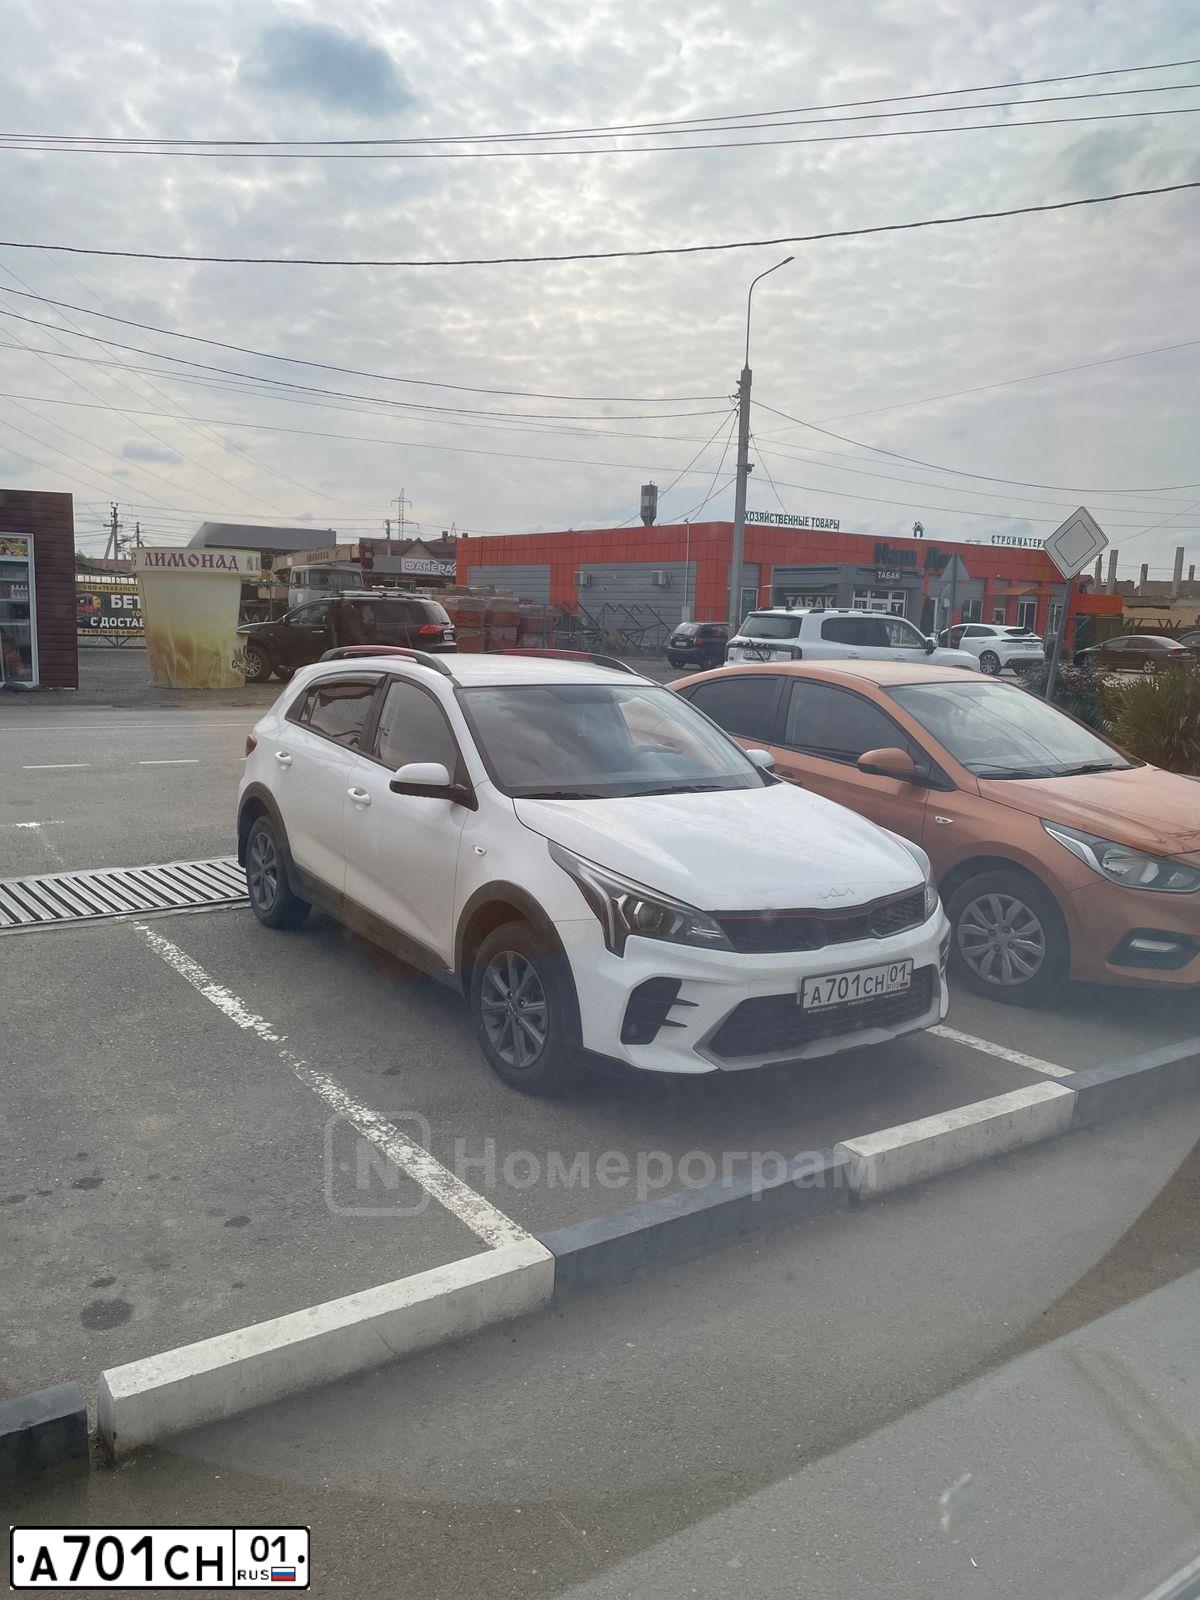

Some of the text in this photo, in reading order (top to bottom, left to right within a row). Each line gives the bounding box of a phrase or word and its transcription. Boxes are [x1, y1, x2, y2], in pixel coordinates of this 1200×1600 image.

[745, 510, 840, 530] ХОЗЯЙСТВЕННЫЕ ТОВАРЫ
[991, 534, 1046, 548] СТРОЙМАТЕР
[144, 552, 239, 571] ЛИМОНАД
[405, 562, 453, 573] ФАНЕРА
[878, 571, 901, 580] ТАБАК
[786, 596, 834, 609] ТАБАК
[90, 617, 98, 626] С
[811, 963, 907, 1005] А701СН 01
